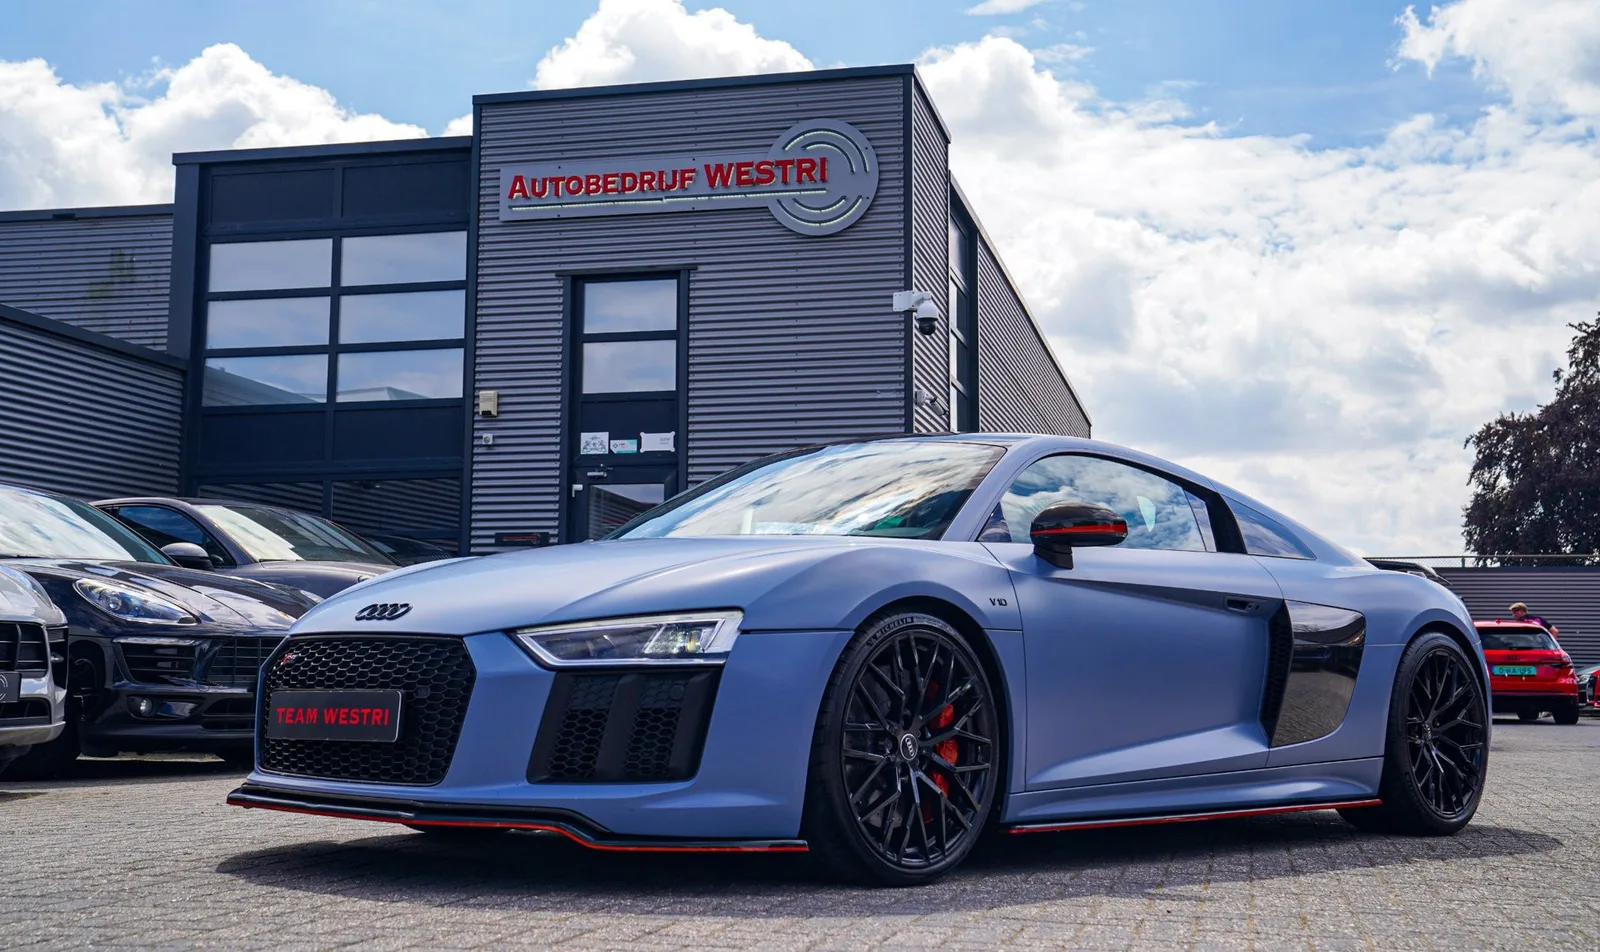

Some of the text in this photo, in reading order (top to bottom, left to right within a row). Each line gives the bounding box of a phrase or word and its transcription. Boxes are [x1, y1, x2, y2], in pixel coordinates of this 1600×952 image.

[508, 156, 828, 199] AUTOBEDRIJF WESTRI
[989, 598, 1008, 607] V10
[875, 617, 913, 637] MICHELIN
[276, 707, 389, 726] TEAM WESTRI
